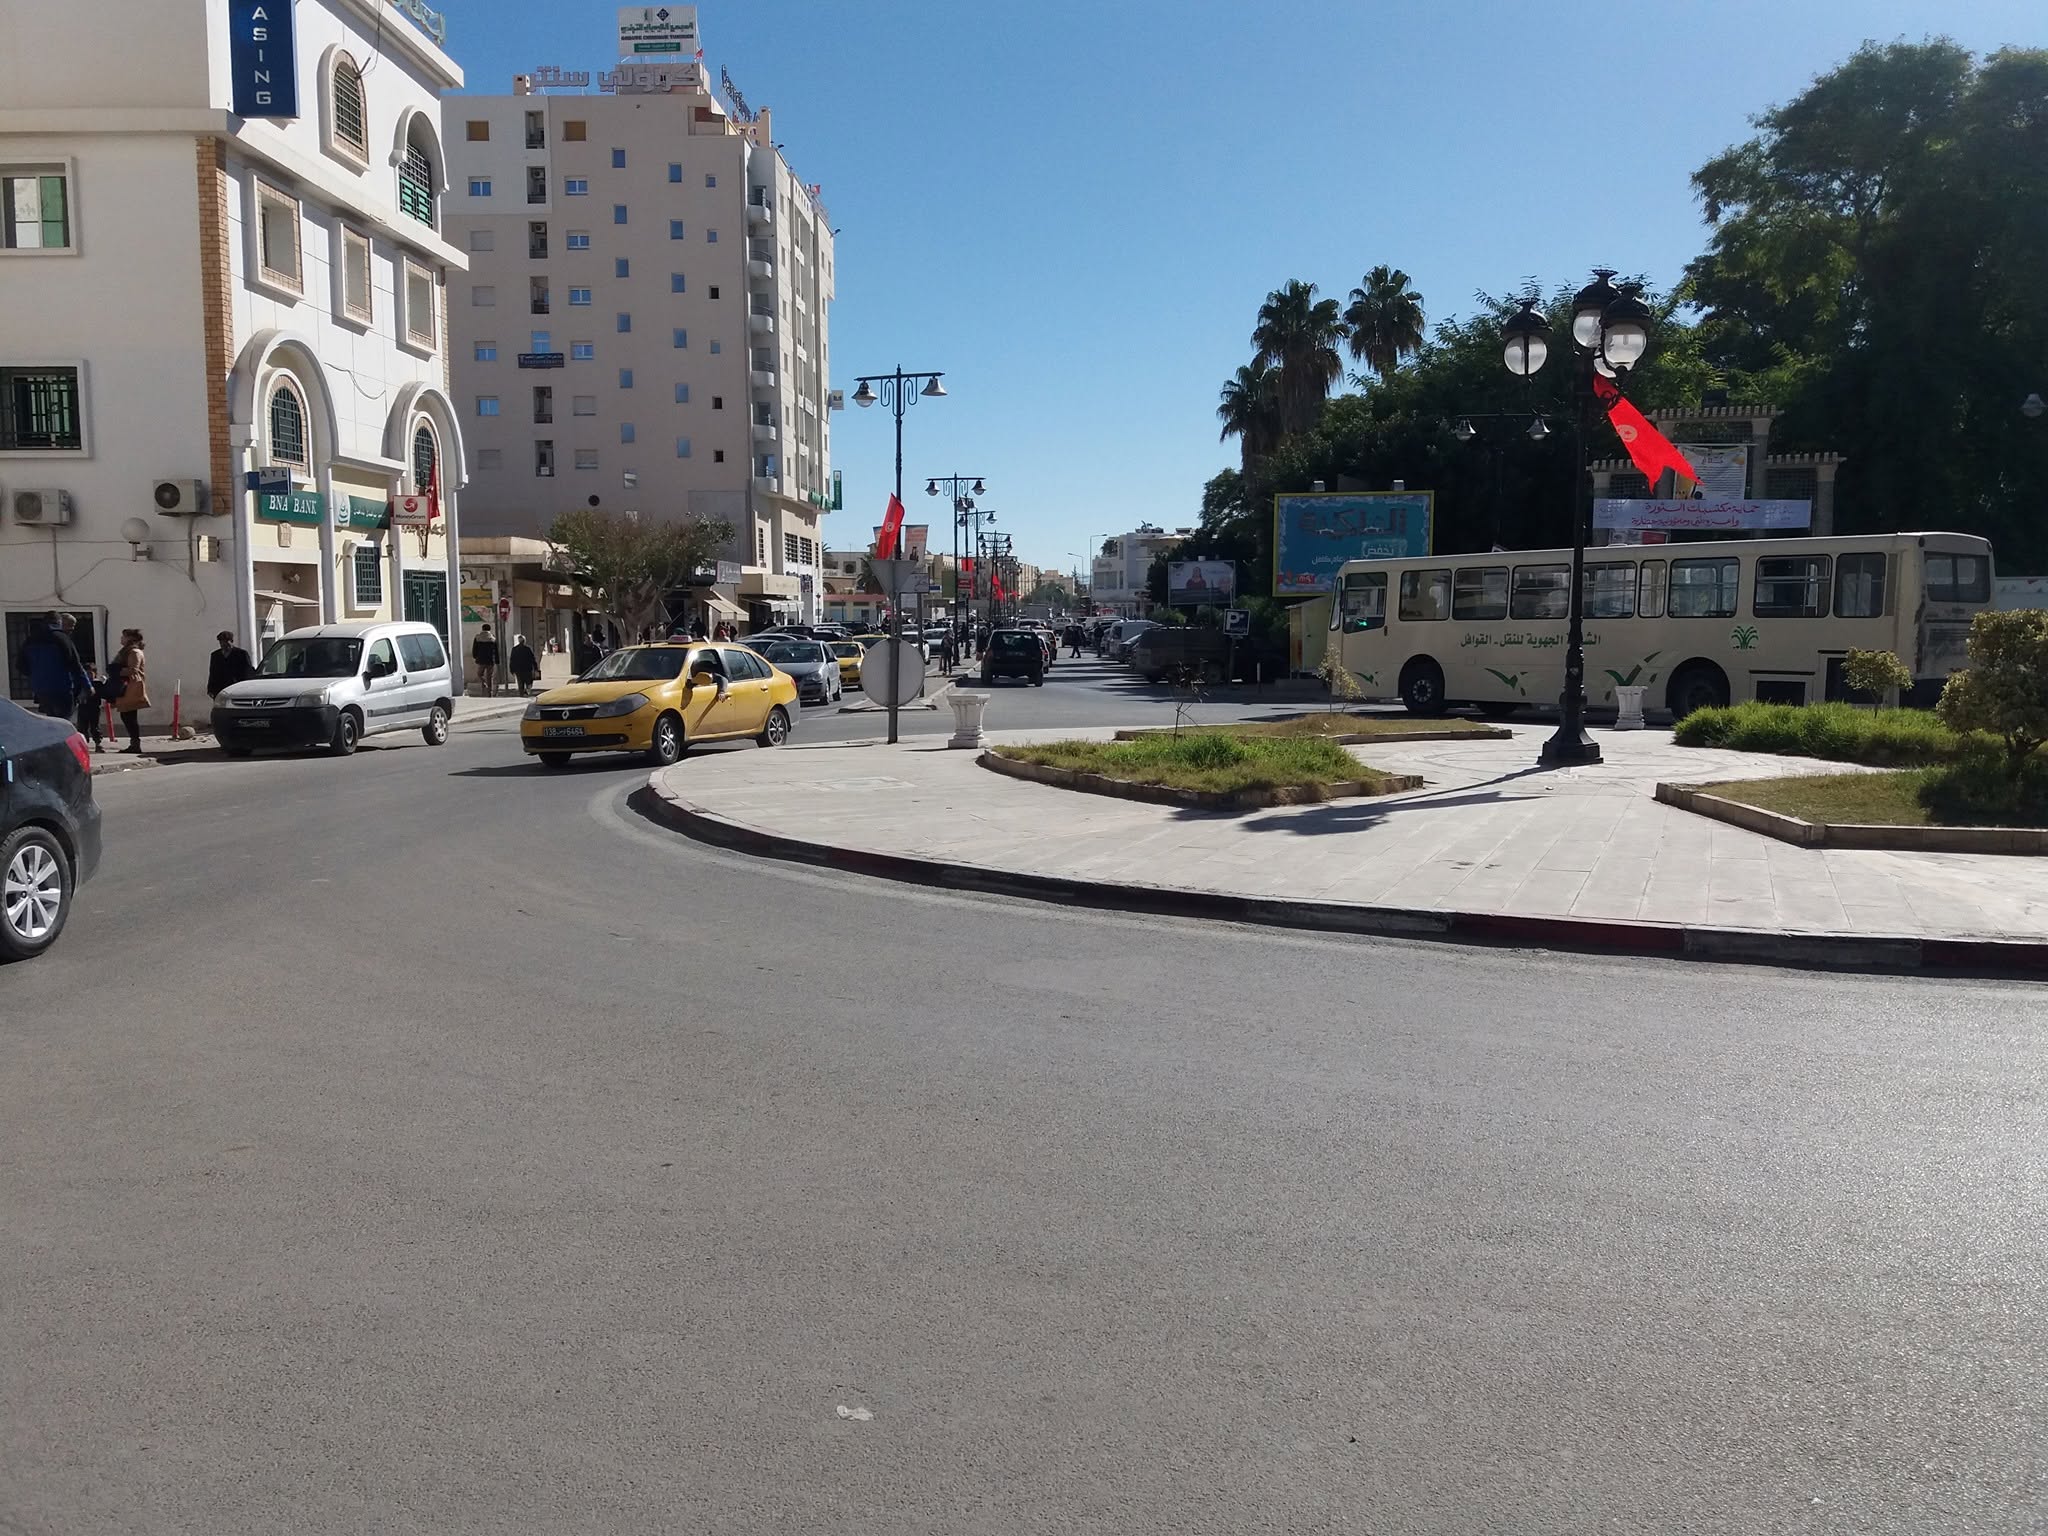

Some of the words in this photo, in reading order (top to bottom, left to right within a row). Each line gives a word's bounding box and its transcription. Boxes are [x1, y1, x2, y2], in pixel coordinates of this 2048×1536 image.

[260, 470, 287, 478] ATL
[269, 495, 288, 511] BNA
[293, 497, 317, 515] BANK
[1460, 633, 1492, 647] القوافل
[1500, 633, 1524, 647] للنقل
[1526, 633, 1564, 648] الجهوية
